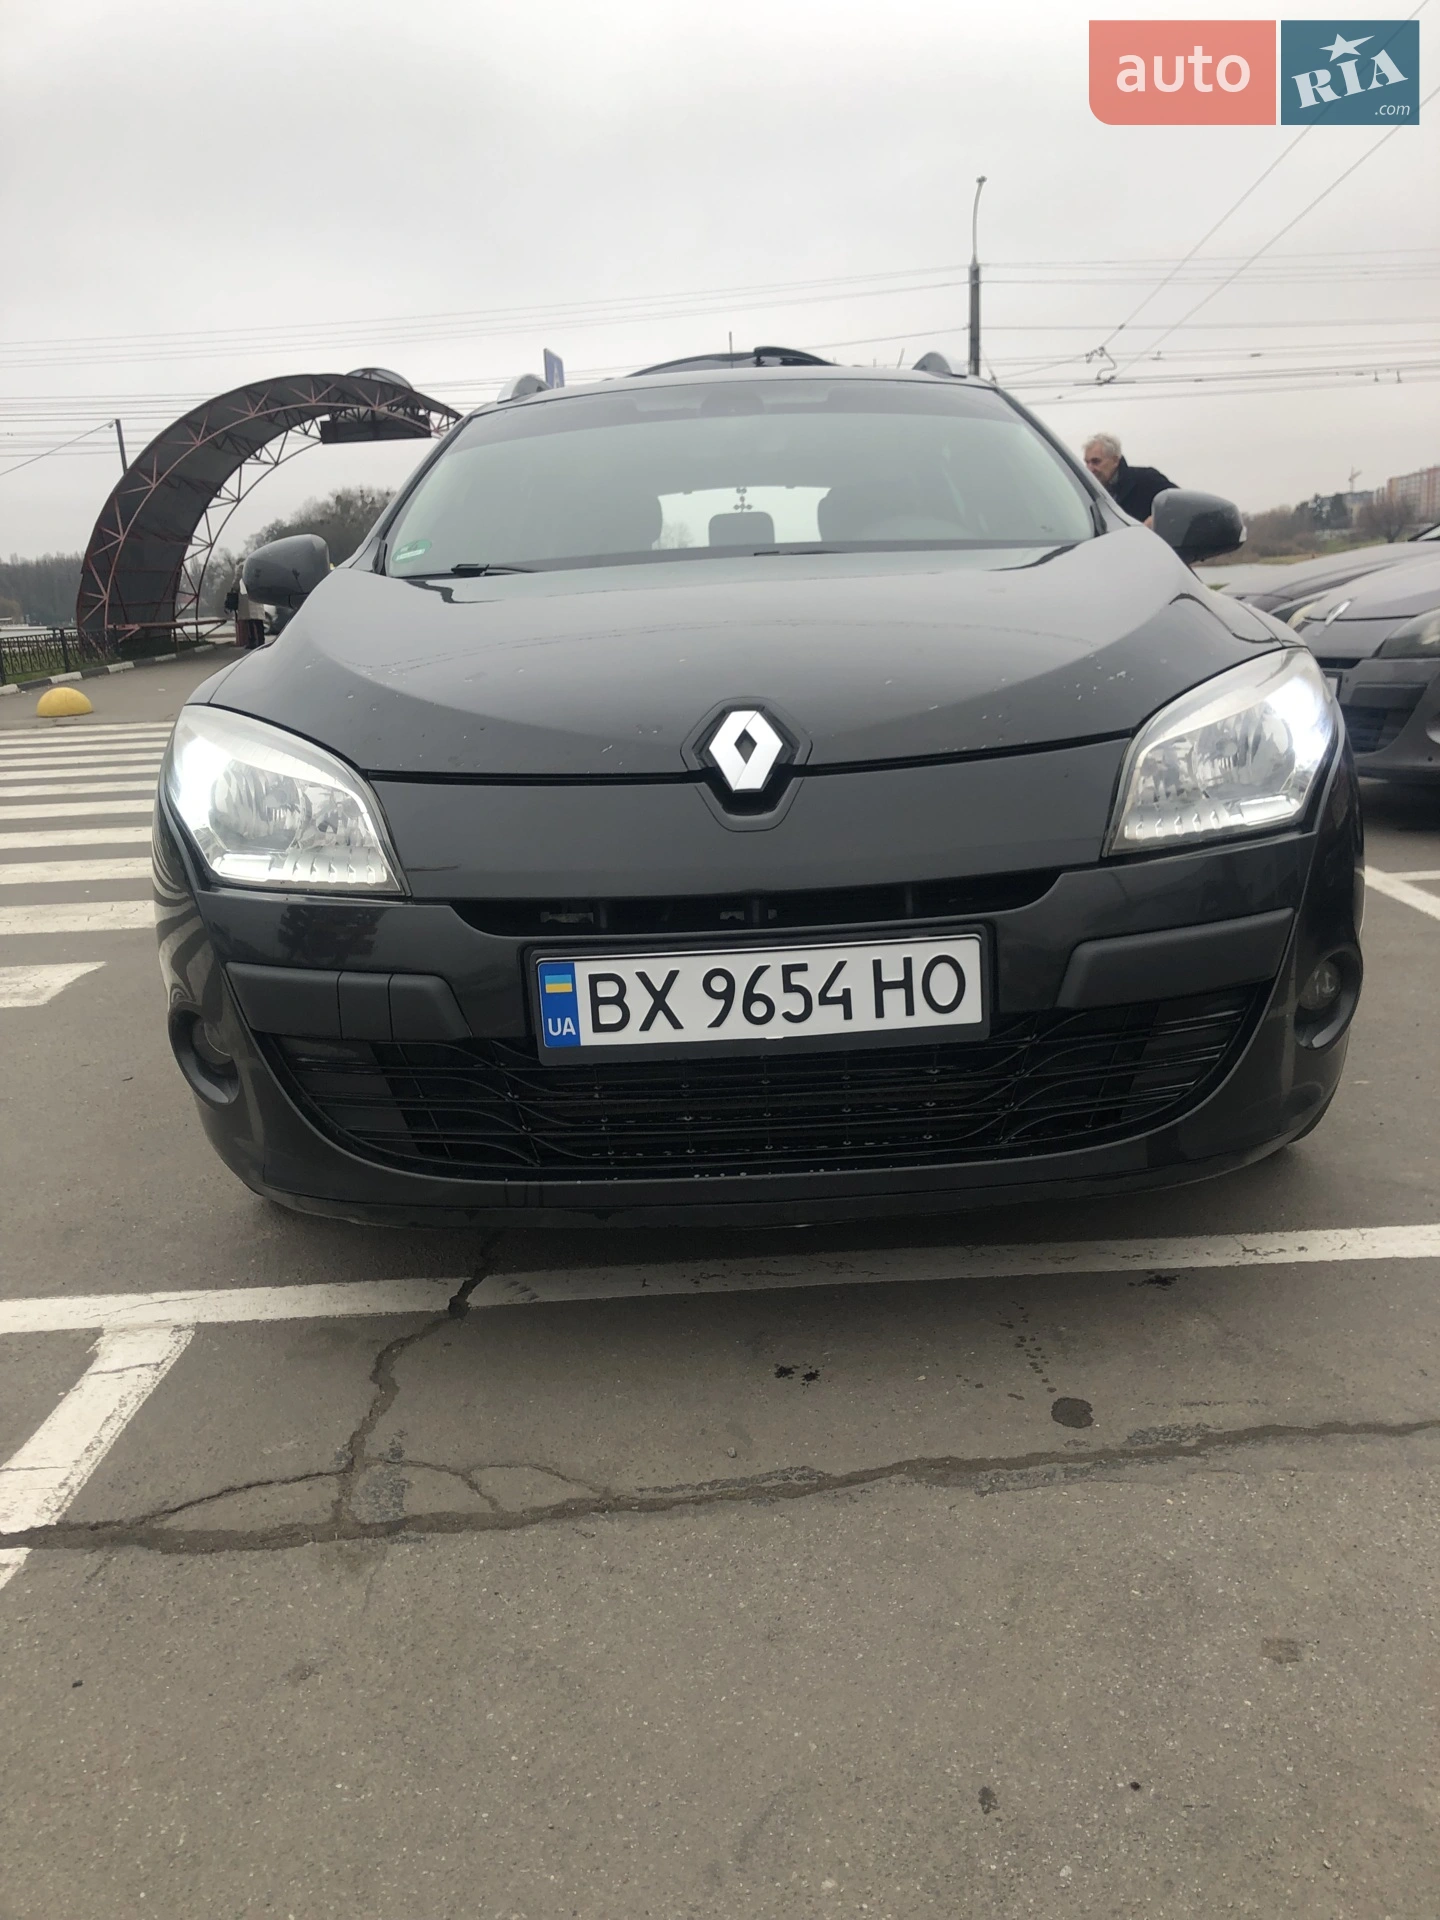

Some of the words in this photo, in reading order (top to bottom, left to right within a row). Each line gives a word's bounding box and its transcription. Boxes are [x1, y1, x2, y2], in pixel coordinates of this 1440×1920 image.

[588, 969, 684, 1033] BX
[702, 960, 853, 1028] 9654
[872, 954, 966, 1019] HO
[547, 1016, 577, 1037] UA
